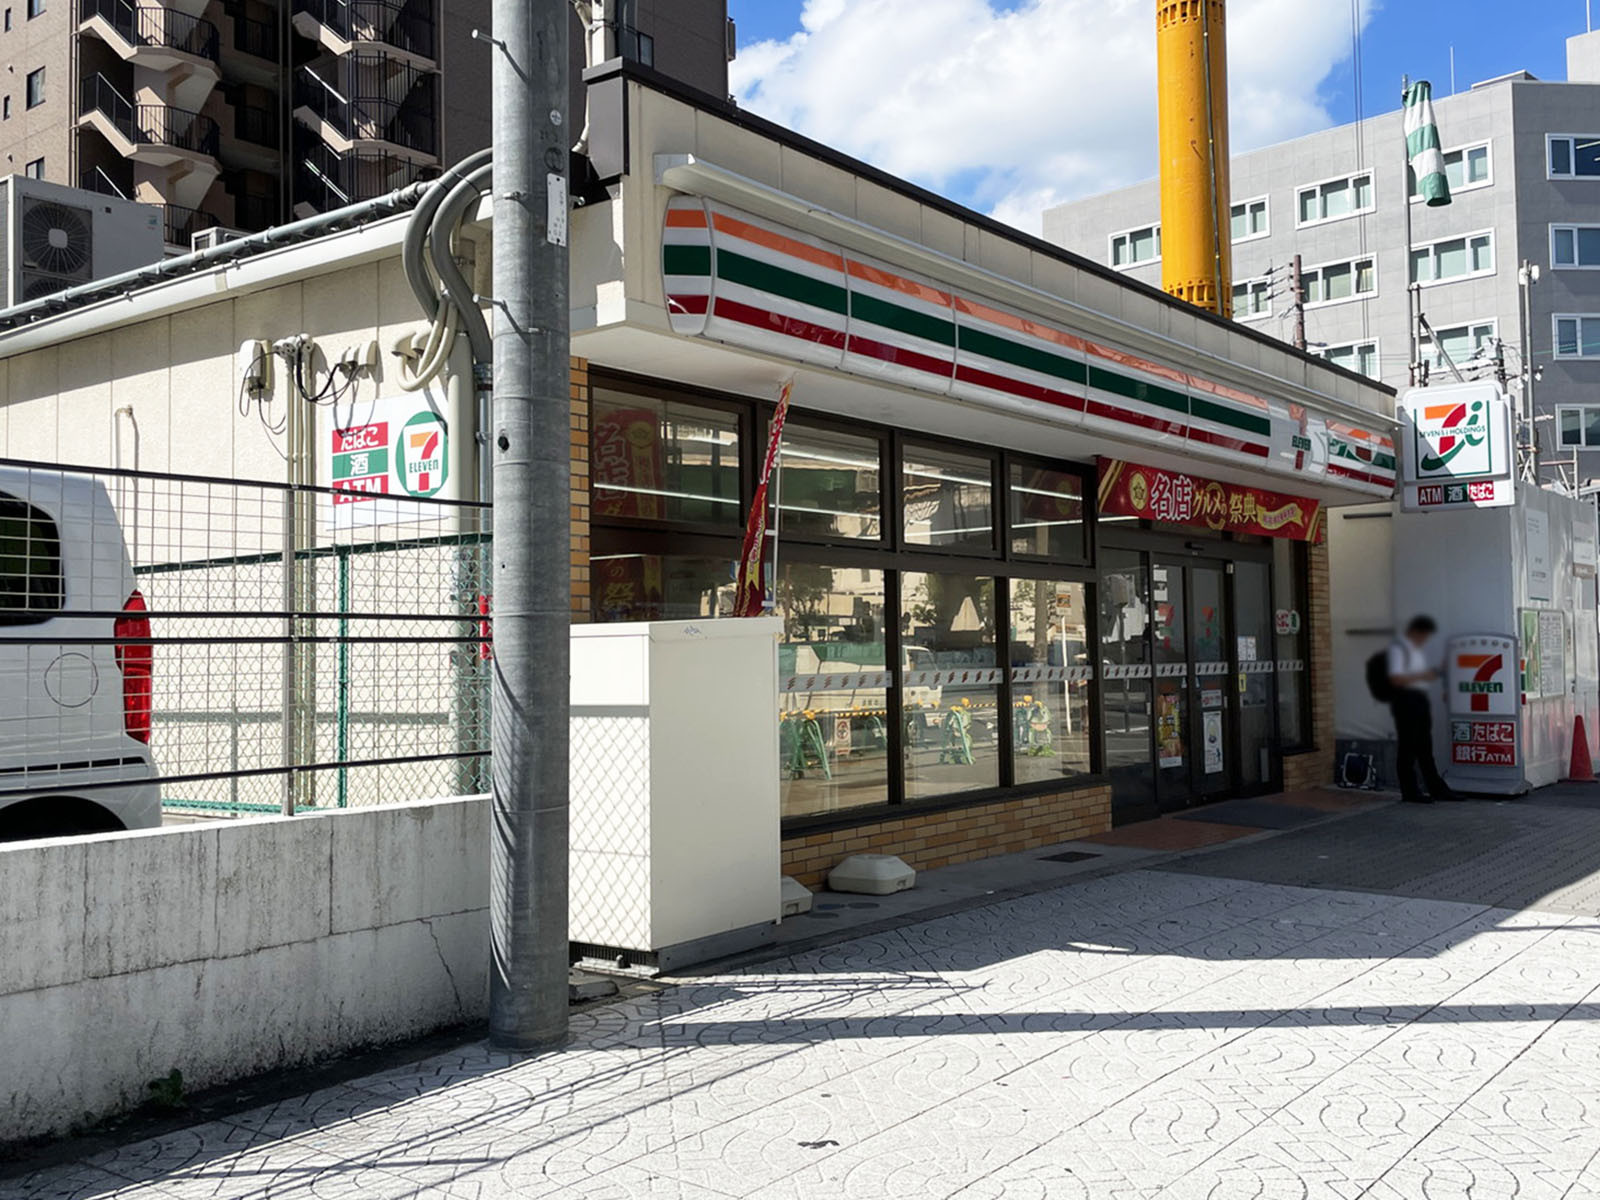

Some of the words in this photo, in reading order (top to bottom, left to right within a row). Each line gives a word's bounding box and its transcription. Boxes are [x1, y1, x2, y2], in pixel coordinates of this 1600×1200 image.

[341, 426, 379, 451] たばこ
[350, 453, 370, 475] 酒
[339, 477, 382, 502] ATM
[1420, 487, 1441, 504] ATM
[1448, 486, 1463, 502] 酒
[1470, 484, 1494, 499] たばこ
[1454, 723, 1471, 741] 酒
[1473, 724, 1513, 742] たばこ
